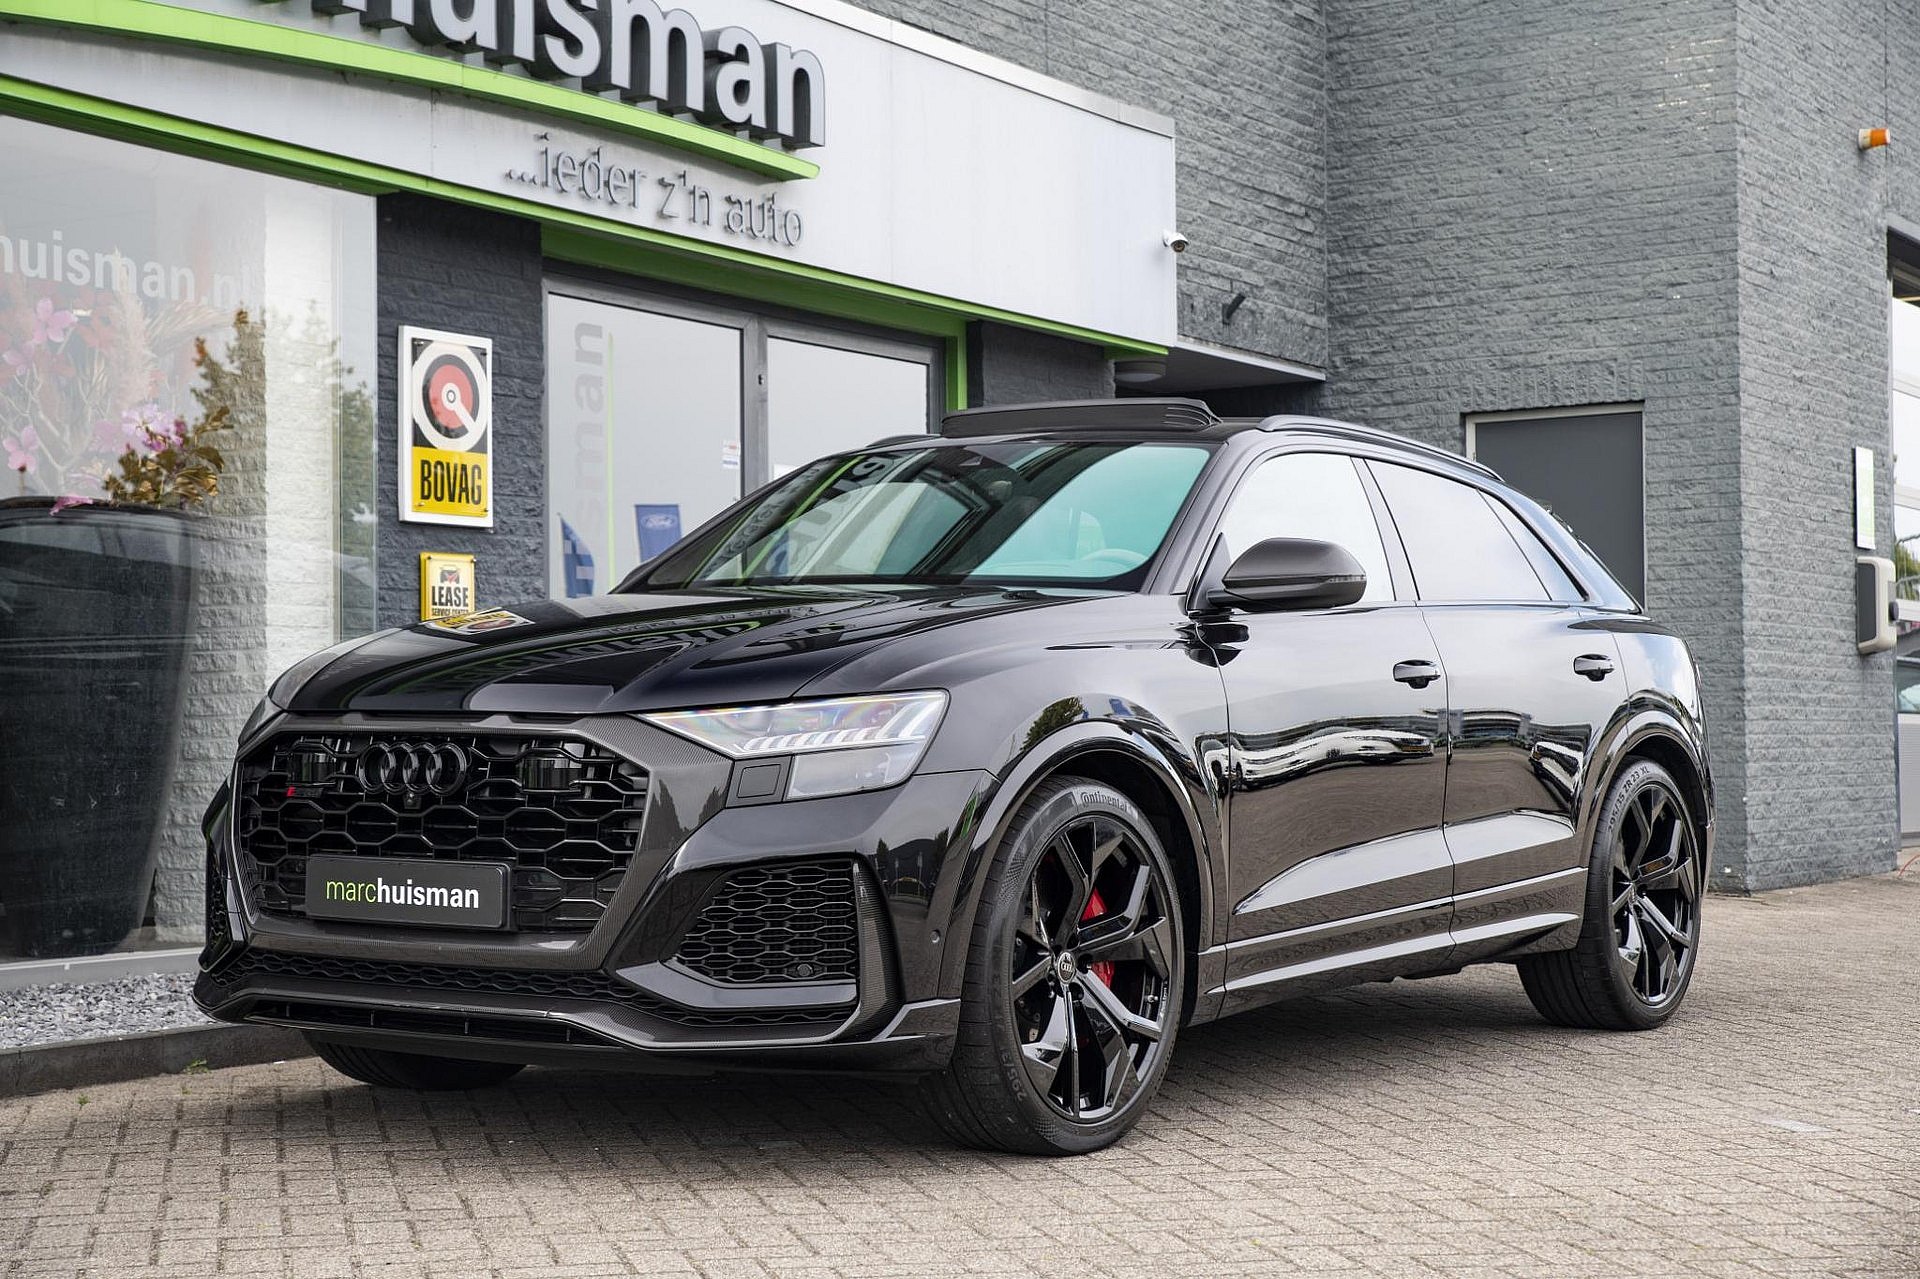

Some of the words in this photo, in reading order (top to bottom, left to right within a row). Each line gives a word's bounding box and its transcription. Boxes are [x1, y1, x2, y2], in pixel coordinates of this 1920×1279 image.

[320, 0, 826, 147] sman
[657, 169, 712, 226] z'n
[724, 191, 804, 246] auto
[420, 459, 482, 505] BOVAG
[431, 586, 469, 607] LEASE
[1080, 791, 1128, 813] Continental
[325, 876, 480, 909] marchuisman
